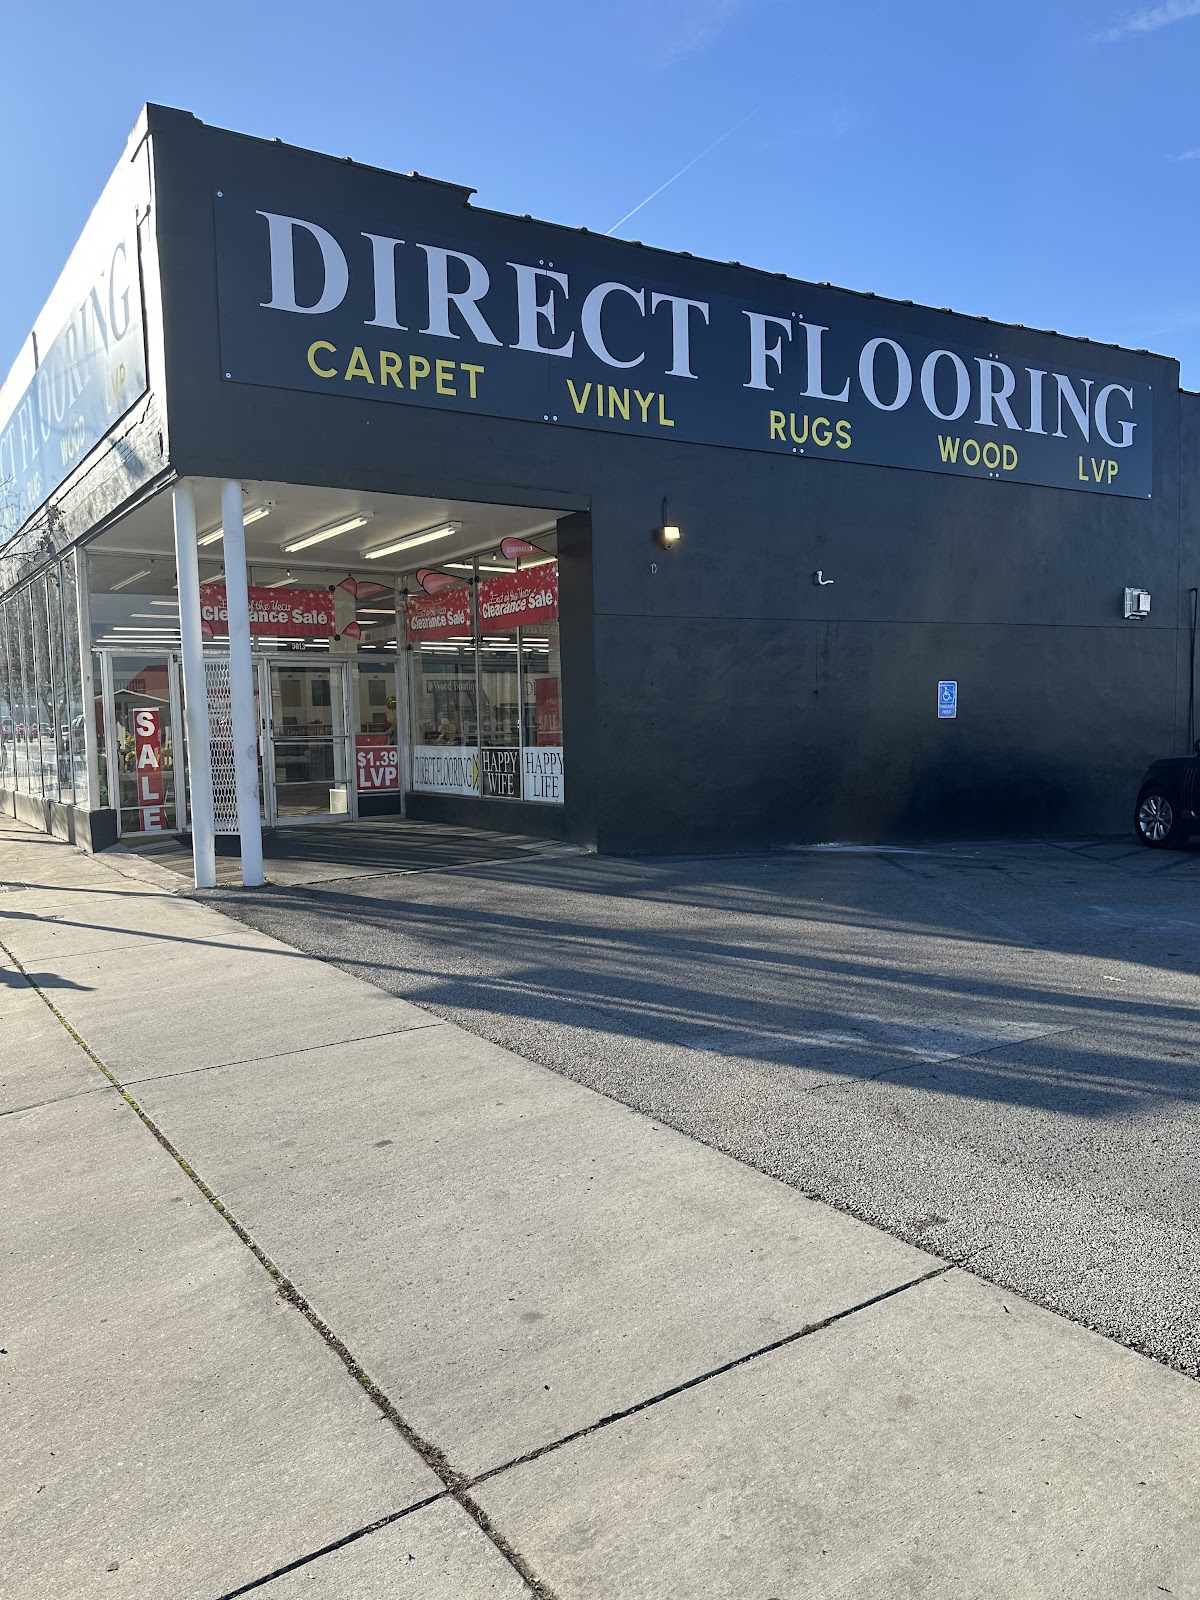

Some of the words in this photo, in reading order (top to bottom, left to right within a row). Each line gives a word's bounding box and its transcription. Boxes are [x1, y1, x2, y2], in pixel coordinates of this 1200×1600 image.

[255, 209, 710, 380] DIRECT
[741, 310, 1138, 449] FLOORING
[307, 340, 485, 400] CARPET
[566, 378, 675, 427] VINYL
[769, 409, 853, 450] RUGS
[937, 434, 1019, 471] WOOD
[1077, 455, 1120, 484] LVP
[59, 415, 86, 467] WOOD
[201, 605, 289, 624] Cleance
[291, 608, 328, 625] Sale
[255, 599, 270, 611] the
[270, 600, 293, 615] Year
[482, 598, 527, 619] Clearance
[527, 589, 553, 609] Sale
[411, 614, 447, 630] Clearance
[446, 610, 466, 626] Sale
[291, 643, 306, 651] 5013
[538, 714, 558, 730] SALE
[357, 751, 398, 769] $1.39
[482, 751, 518, 773] HAPPY
[525, 752, 564, 775] HAPPY
[136, 711, 162, 832] SALE
[359, 767, 397, 788] LVP
[487, 773, 515, 795] WIFE
[533, 775, 560, 799] LIFE
